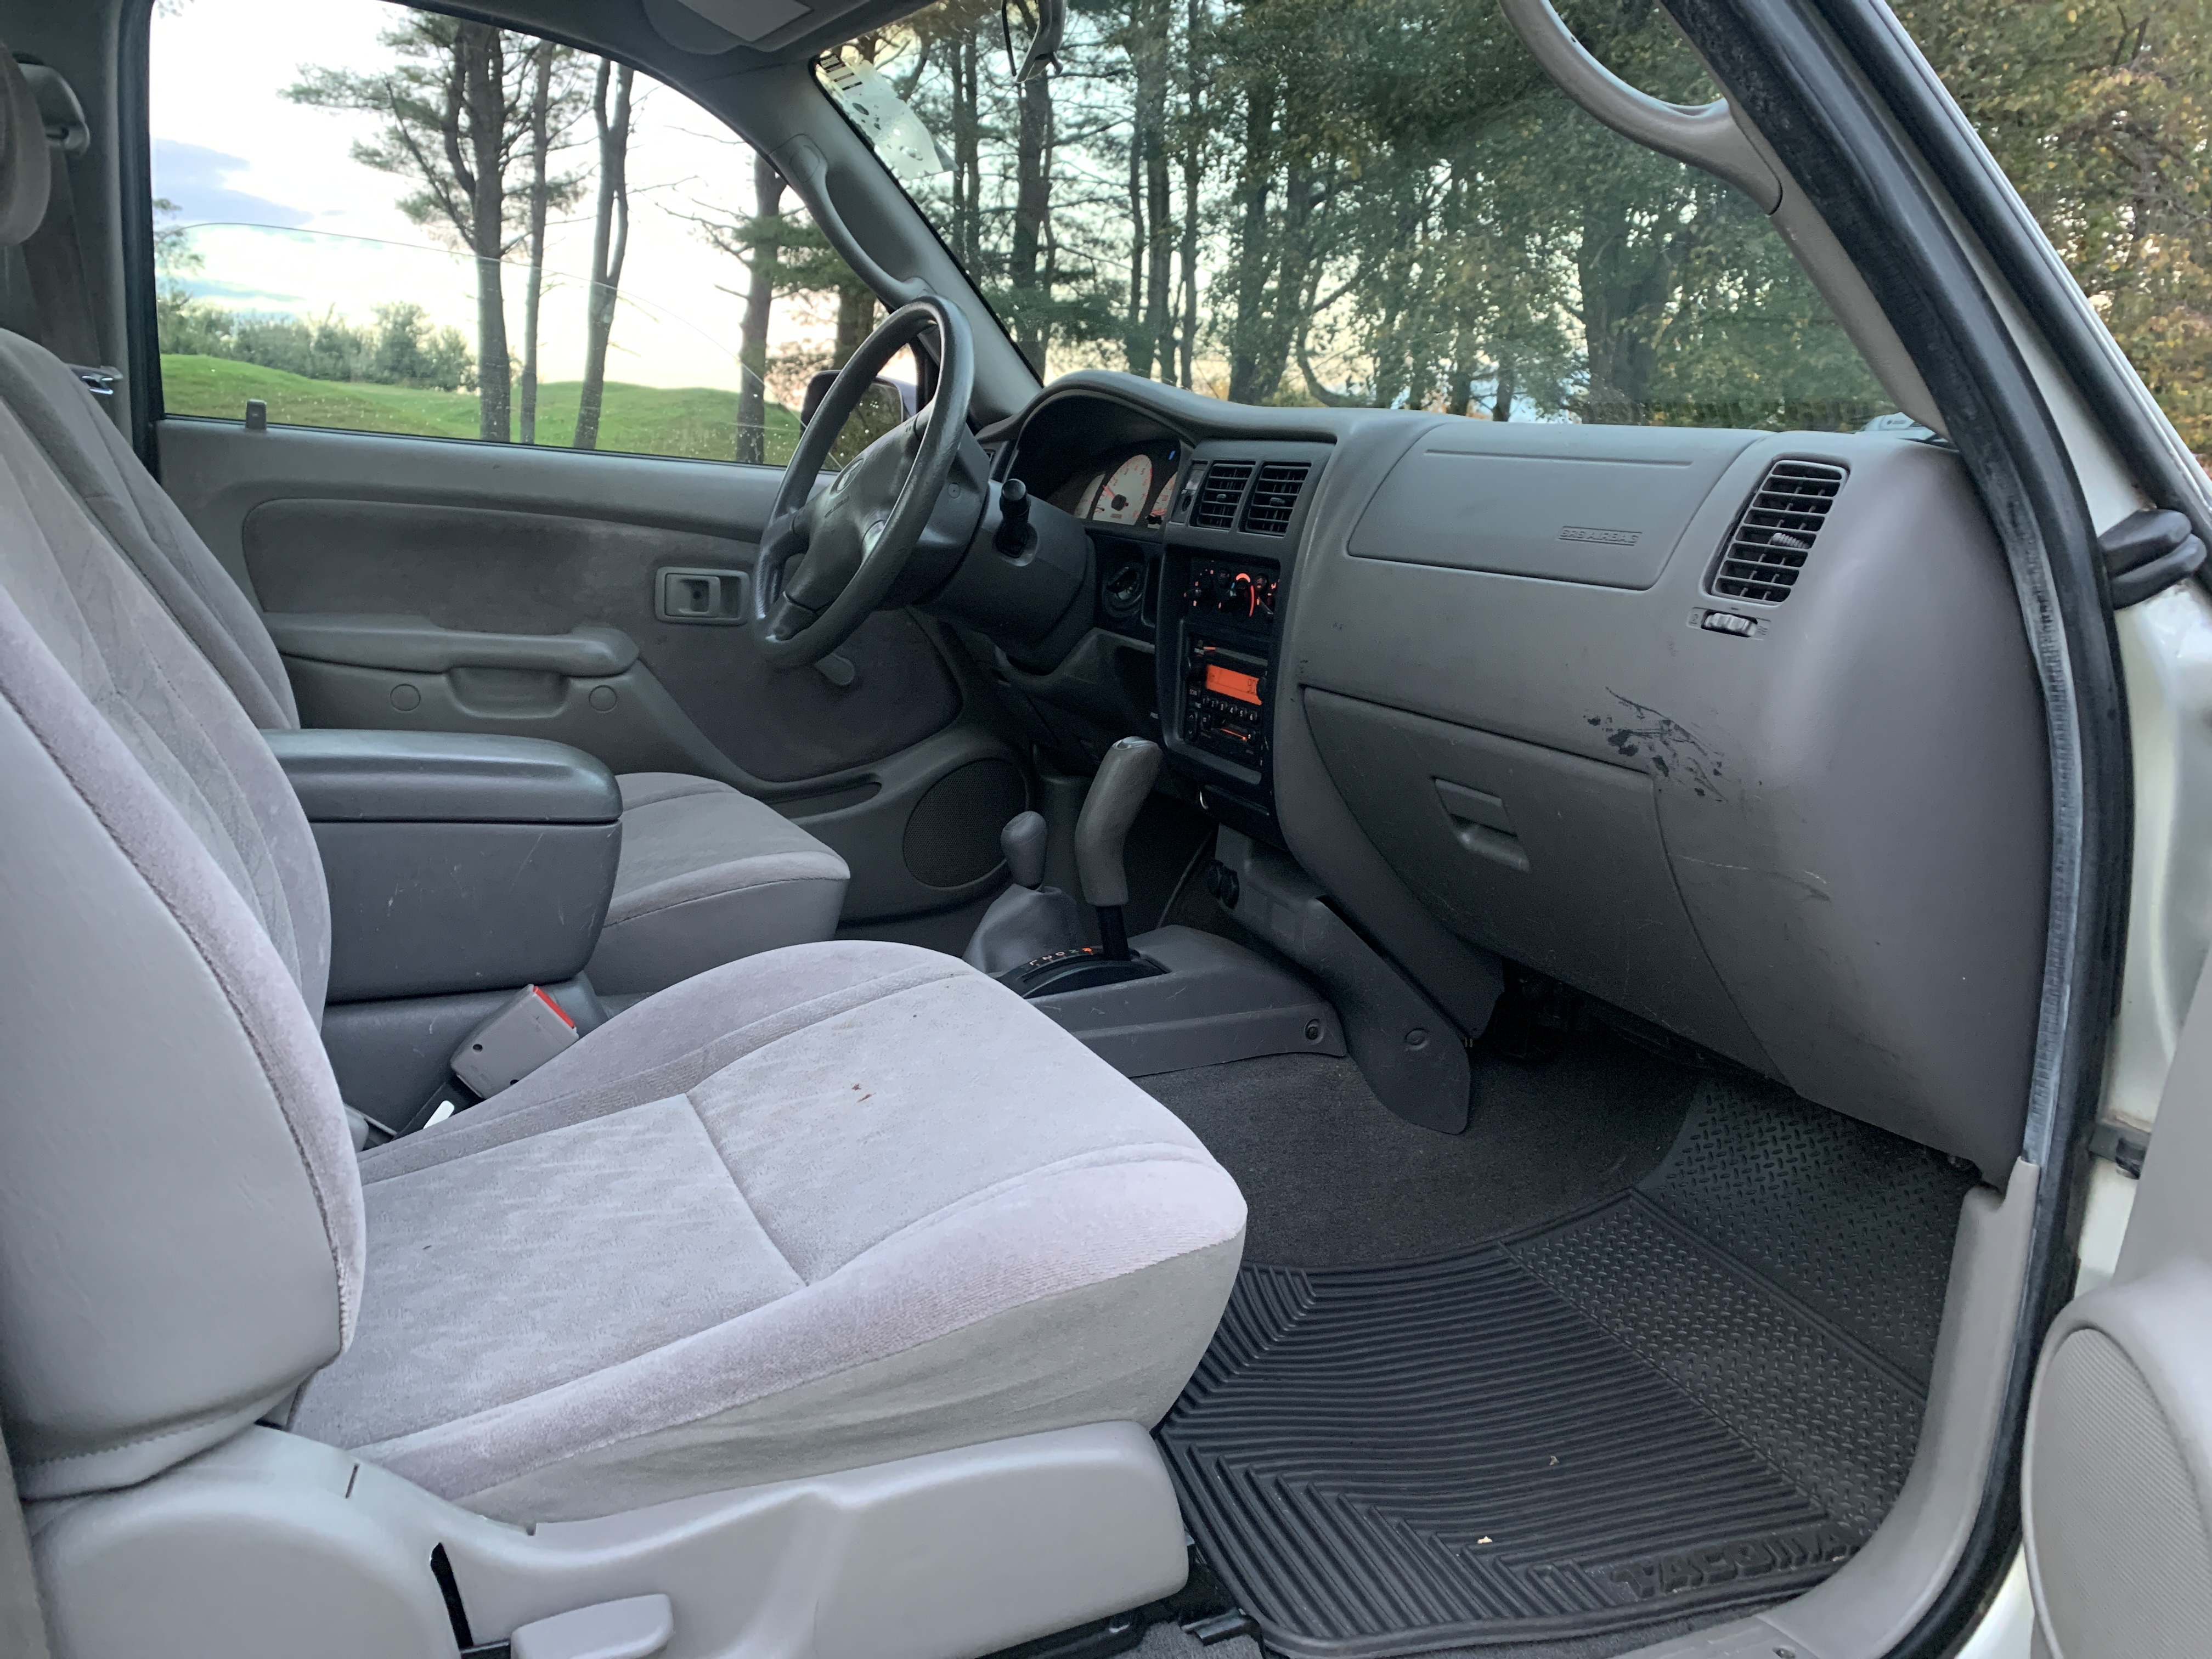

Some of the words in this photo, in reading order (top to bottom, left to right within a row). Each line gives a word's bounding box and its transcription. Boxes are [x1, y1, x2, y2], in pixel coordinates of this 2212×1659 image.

[1560, 529, 1585, 539] SRS
[1586, 532, 1639, 543] AIRBAG
[1610, 1532, 1861, 1598] TACOMA
